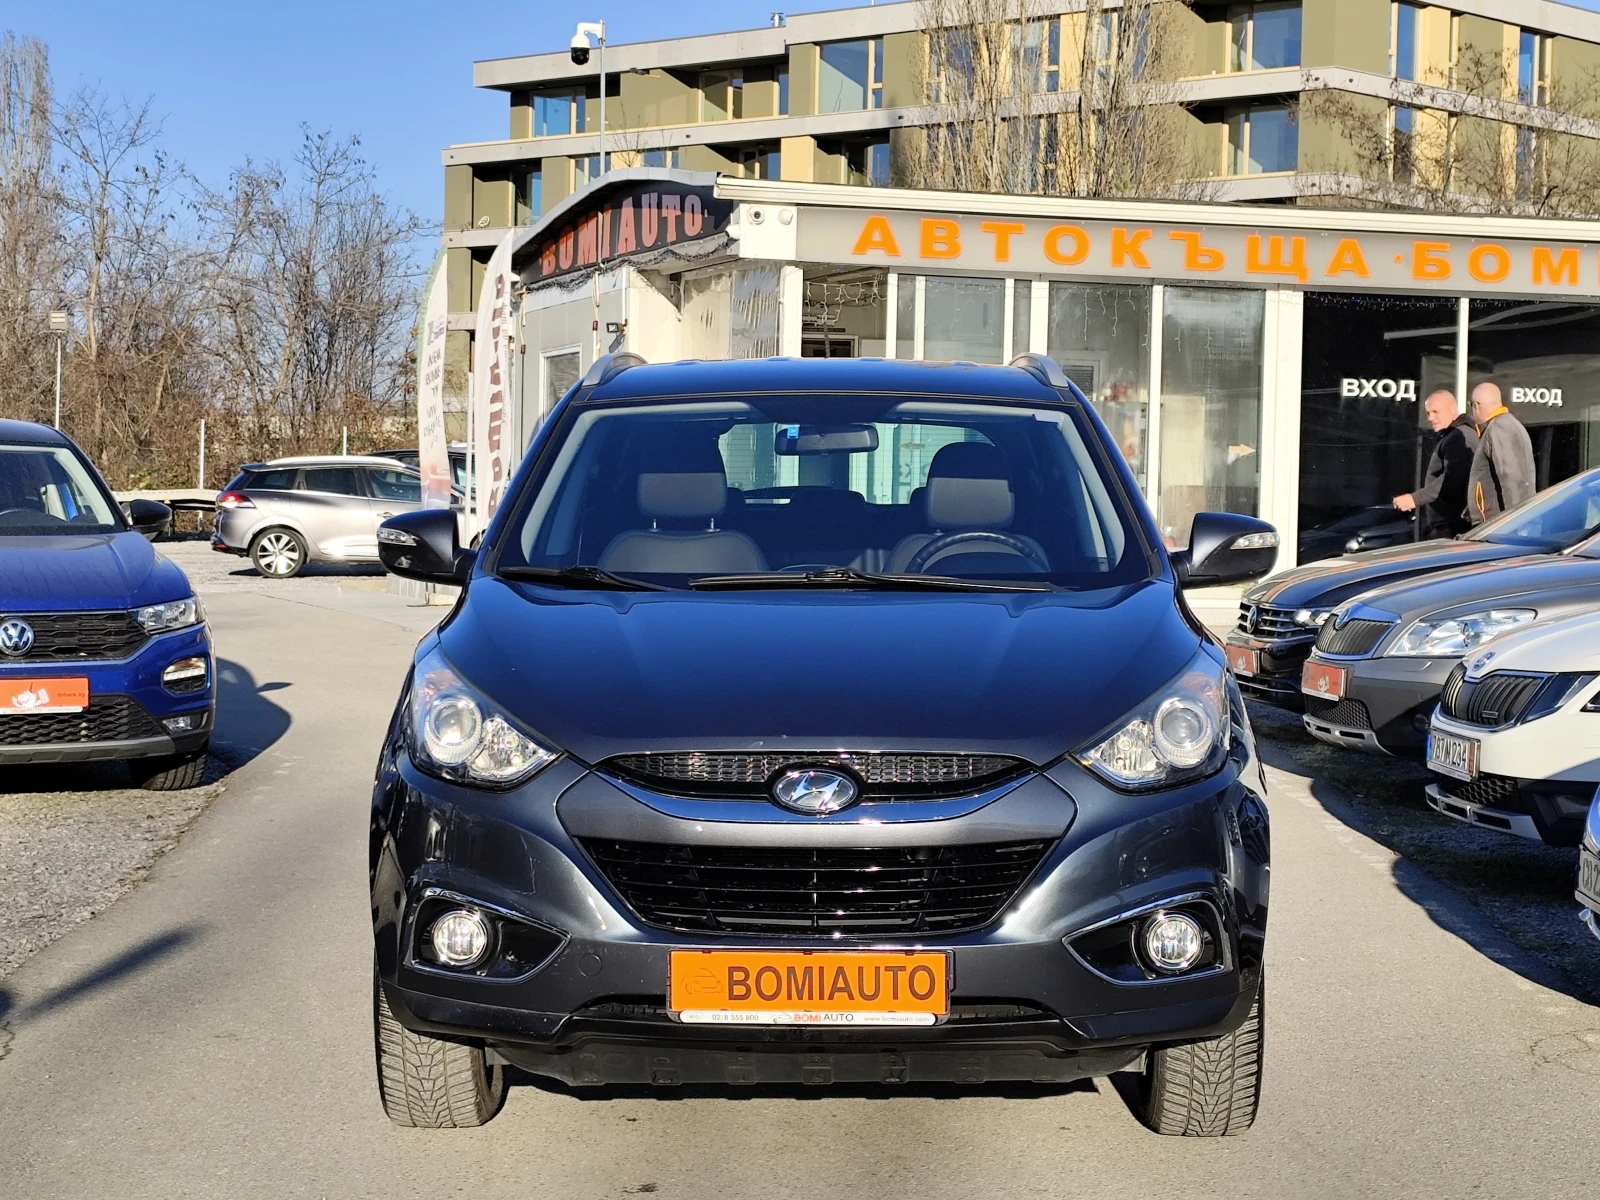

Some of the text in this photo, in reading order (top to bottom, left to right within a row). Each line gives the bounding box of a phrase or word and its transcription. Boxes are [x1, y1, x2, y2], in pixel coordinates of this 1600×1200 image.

[1411, 240, 1600, 288] БОМ
[1342, 378, 1417, 402] ВХОД
[1512, 387, 1563, 407] ВХОД
[727, 964, 936, 1002] BOMIAUTO
[731, 1013, 744, 1021] 555
[745, 1013, 759, 1022] 800
[793, 1013, 822, 1023] BOMI
[823, 1013, 854, 1022] AUTO
